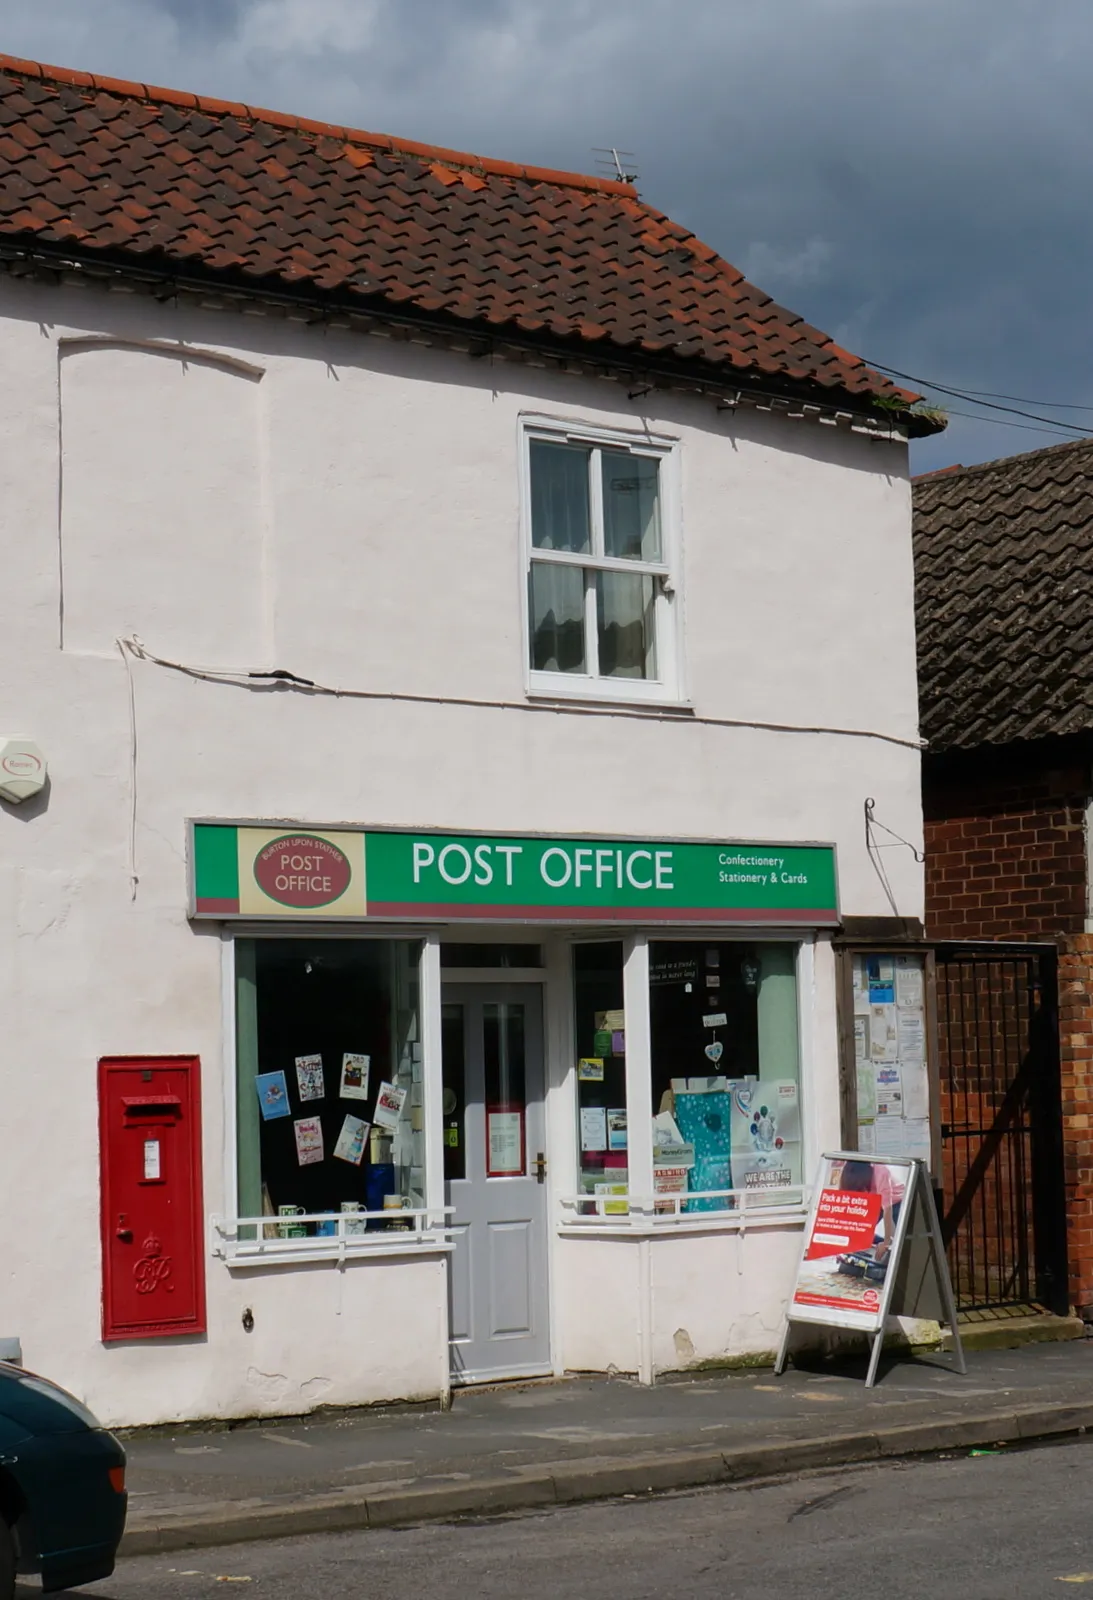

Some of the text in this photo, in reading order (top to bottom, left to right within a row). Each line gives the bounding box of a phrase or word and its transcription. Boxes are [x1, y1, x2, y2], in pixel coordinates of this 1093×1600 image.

[262, 839, 343, 863] BURTON UPON STATHER
[413, 843, 674, 889] POST OFFICE
[718, 853, 784, 869] Confectionery
[275, 854, 332, 892] POST OFFICE
[719, 871, 808, 886] Stationery & Cards
[744, 1169, 791, 1183] WE ARE THE
[851, 1197, 868, 1206] extra
[831, 1206, 846, 1214] your
[847, 1206, 868, 1217] holiday
